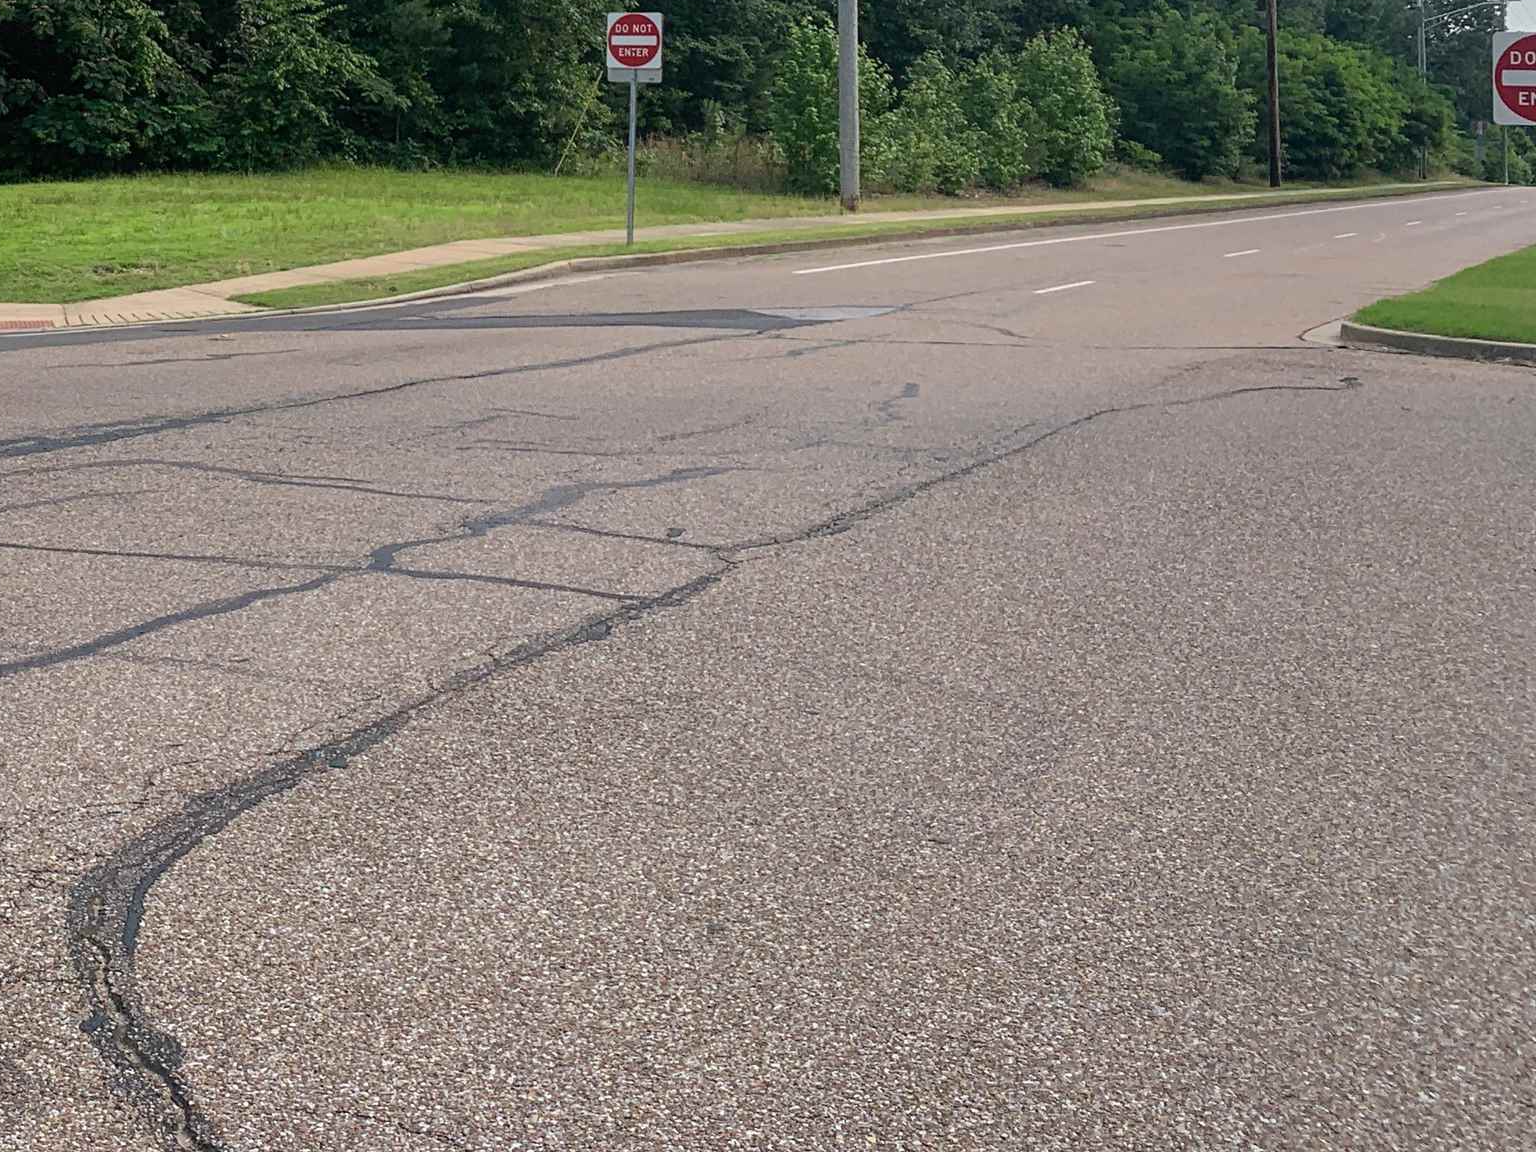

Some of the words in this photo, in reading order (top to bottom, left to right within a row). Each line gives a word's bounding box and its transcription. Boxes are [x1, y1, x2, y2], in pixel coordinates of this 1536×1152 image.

[615, 24, 628, 33] DO
[632, 24, 652, 33] NOT
[619, 48, 649, 57] ENTER
[1510, 51, 1536, 65] DO
